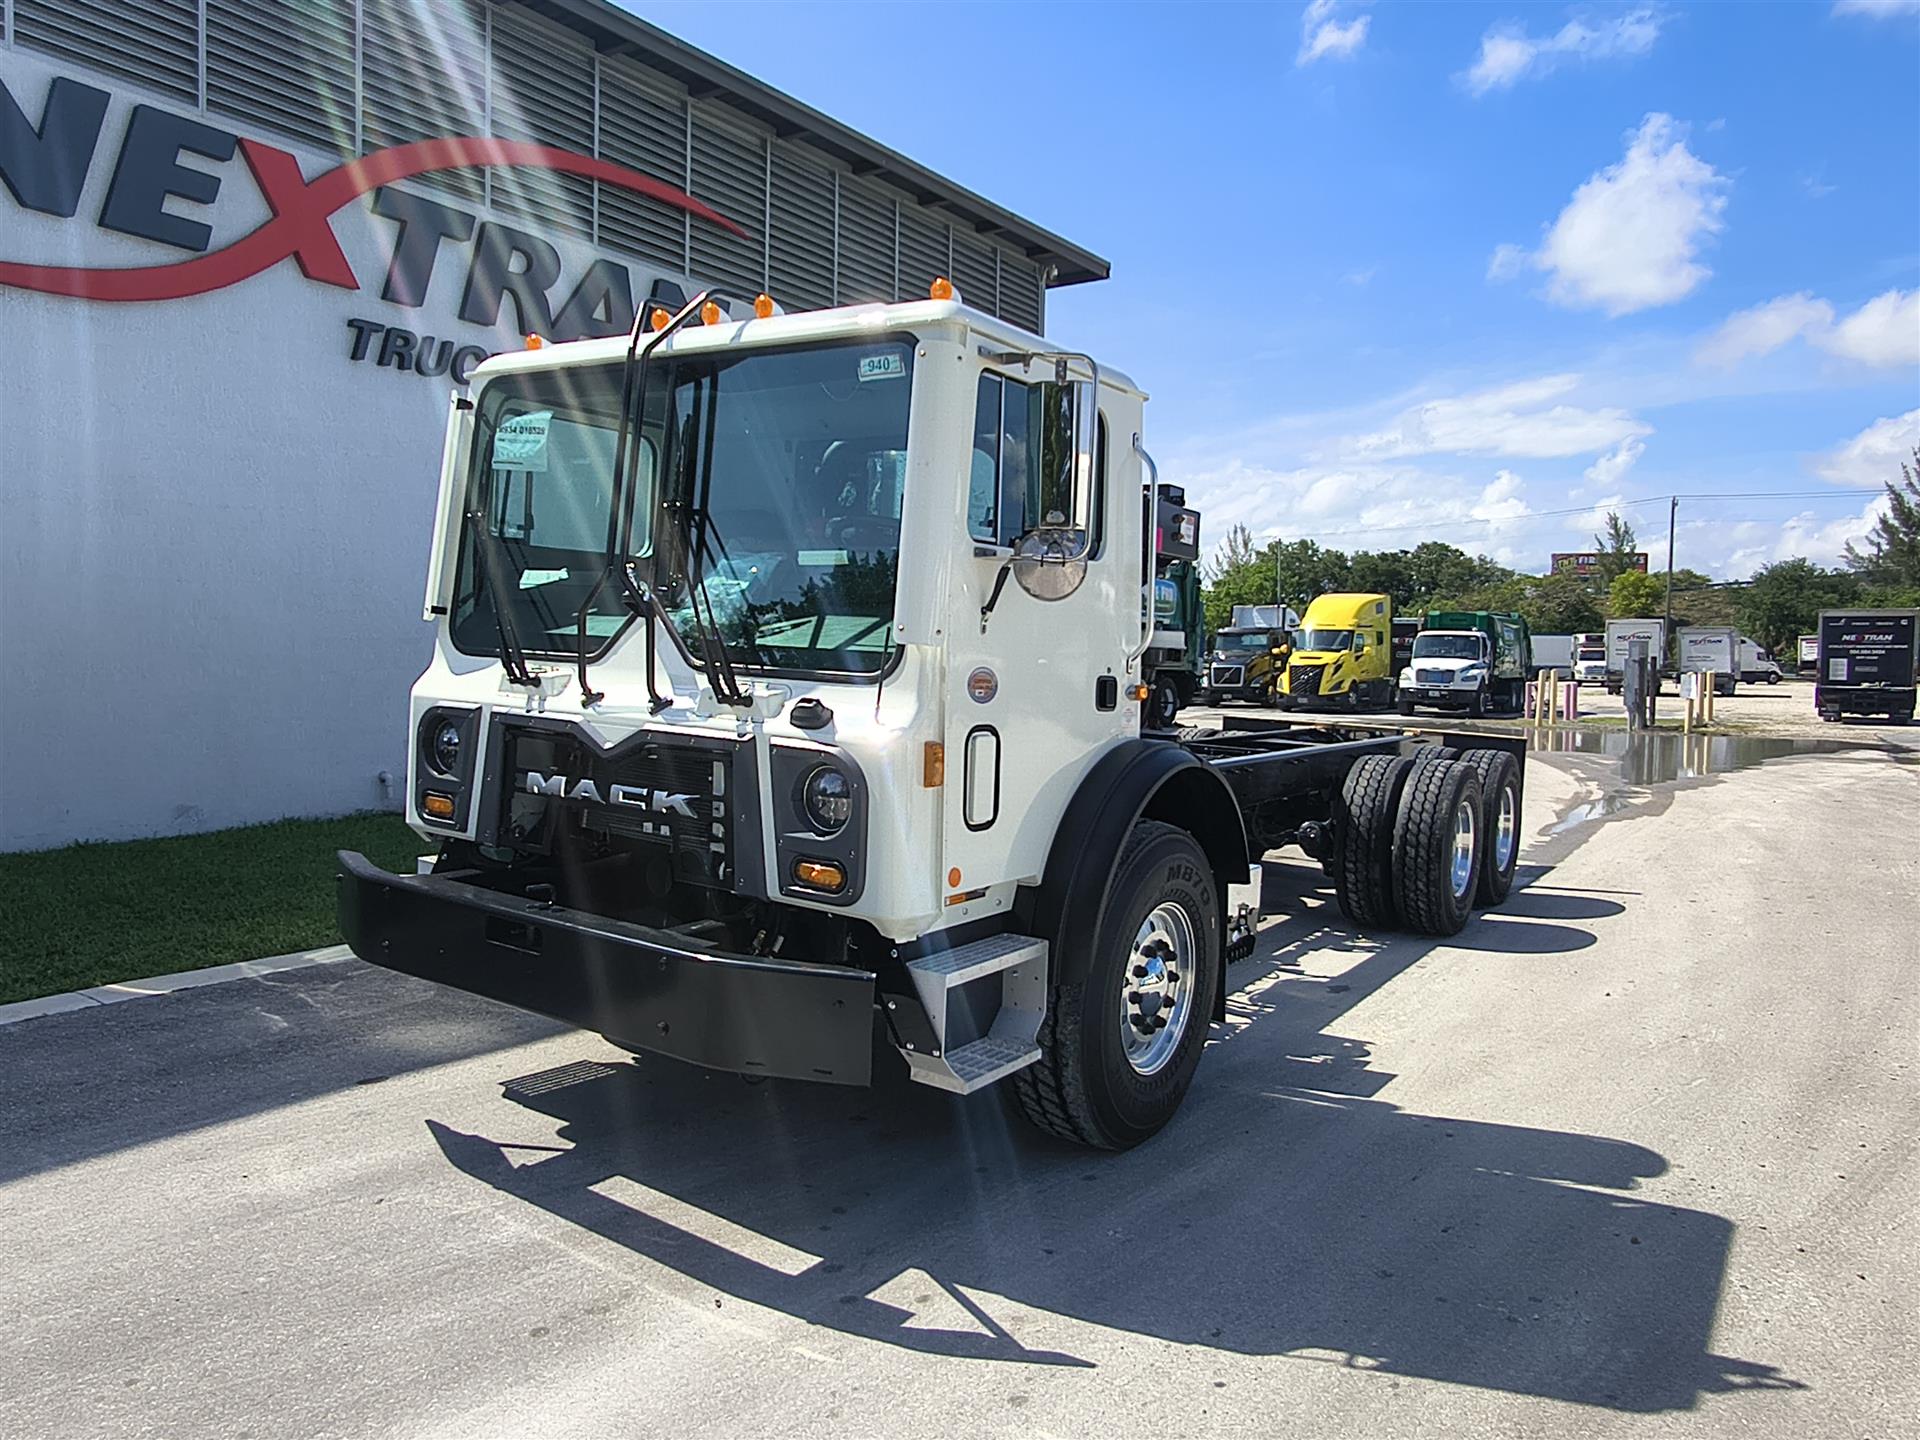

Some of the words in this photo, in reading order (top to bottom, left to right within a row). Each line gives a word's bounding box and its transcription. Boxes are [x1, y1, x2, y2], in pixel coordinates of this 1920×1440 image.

[347, 318, 500, 386] TRUC
[867, 357, 890, 372] 940
[526, 771, 701, 819] MACK
